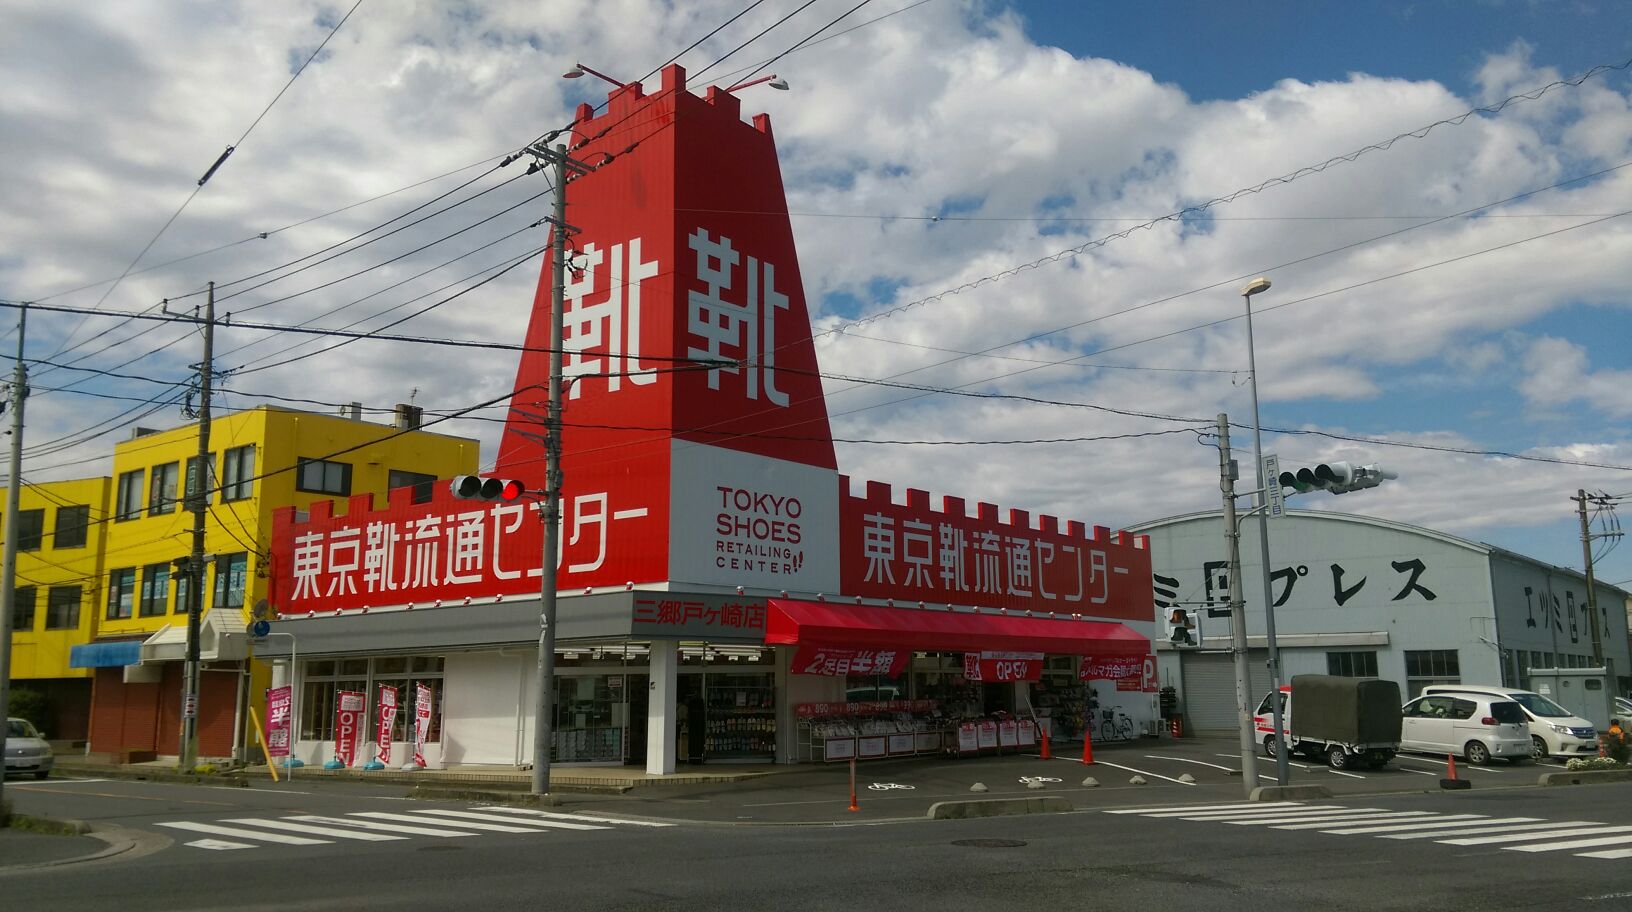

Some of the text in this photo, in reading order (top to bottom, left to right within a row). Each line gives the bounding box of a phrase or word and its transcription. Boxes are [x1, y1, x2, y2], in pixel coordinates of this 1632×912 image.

[563, 237, 658, 400] 靴
[688, 227, 789, 408] 靴
[717, 486, 802, 519] TOKYO
[716, 513, 801, 544] SHOES
[291, 492, 648, 600] 東京靴流通センター
[716, 540, 791, 559] RETAILING
[864, 512, 1129, 604] 東京靴流通センター
[716, 557, 791, 574] CENTER
[1143, 659, 1153, 688] P
